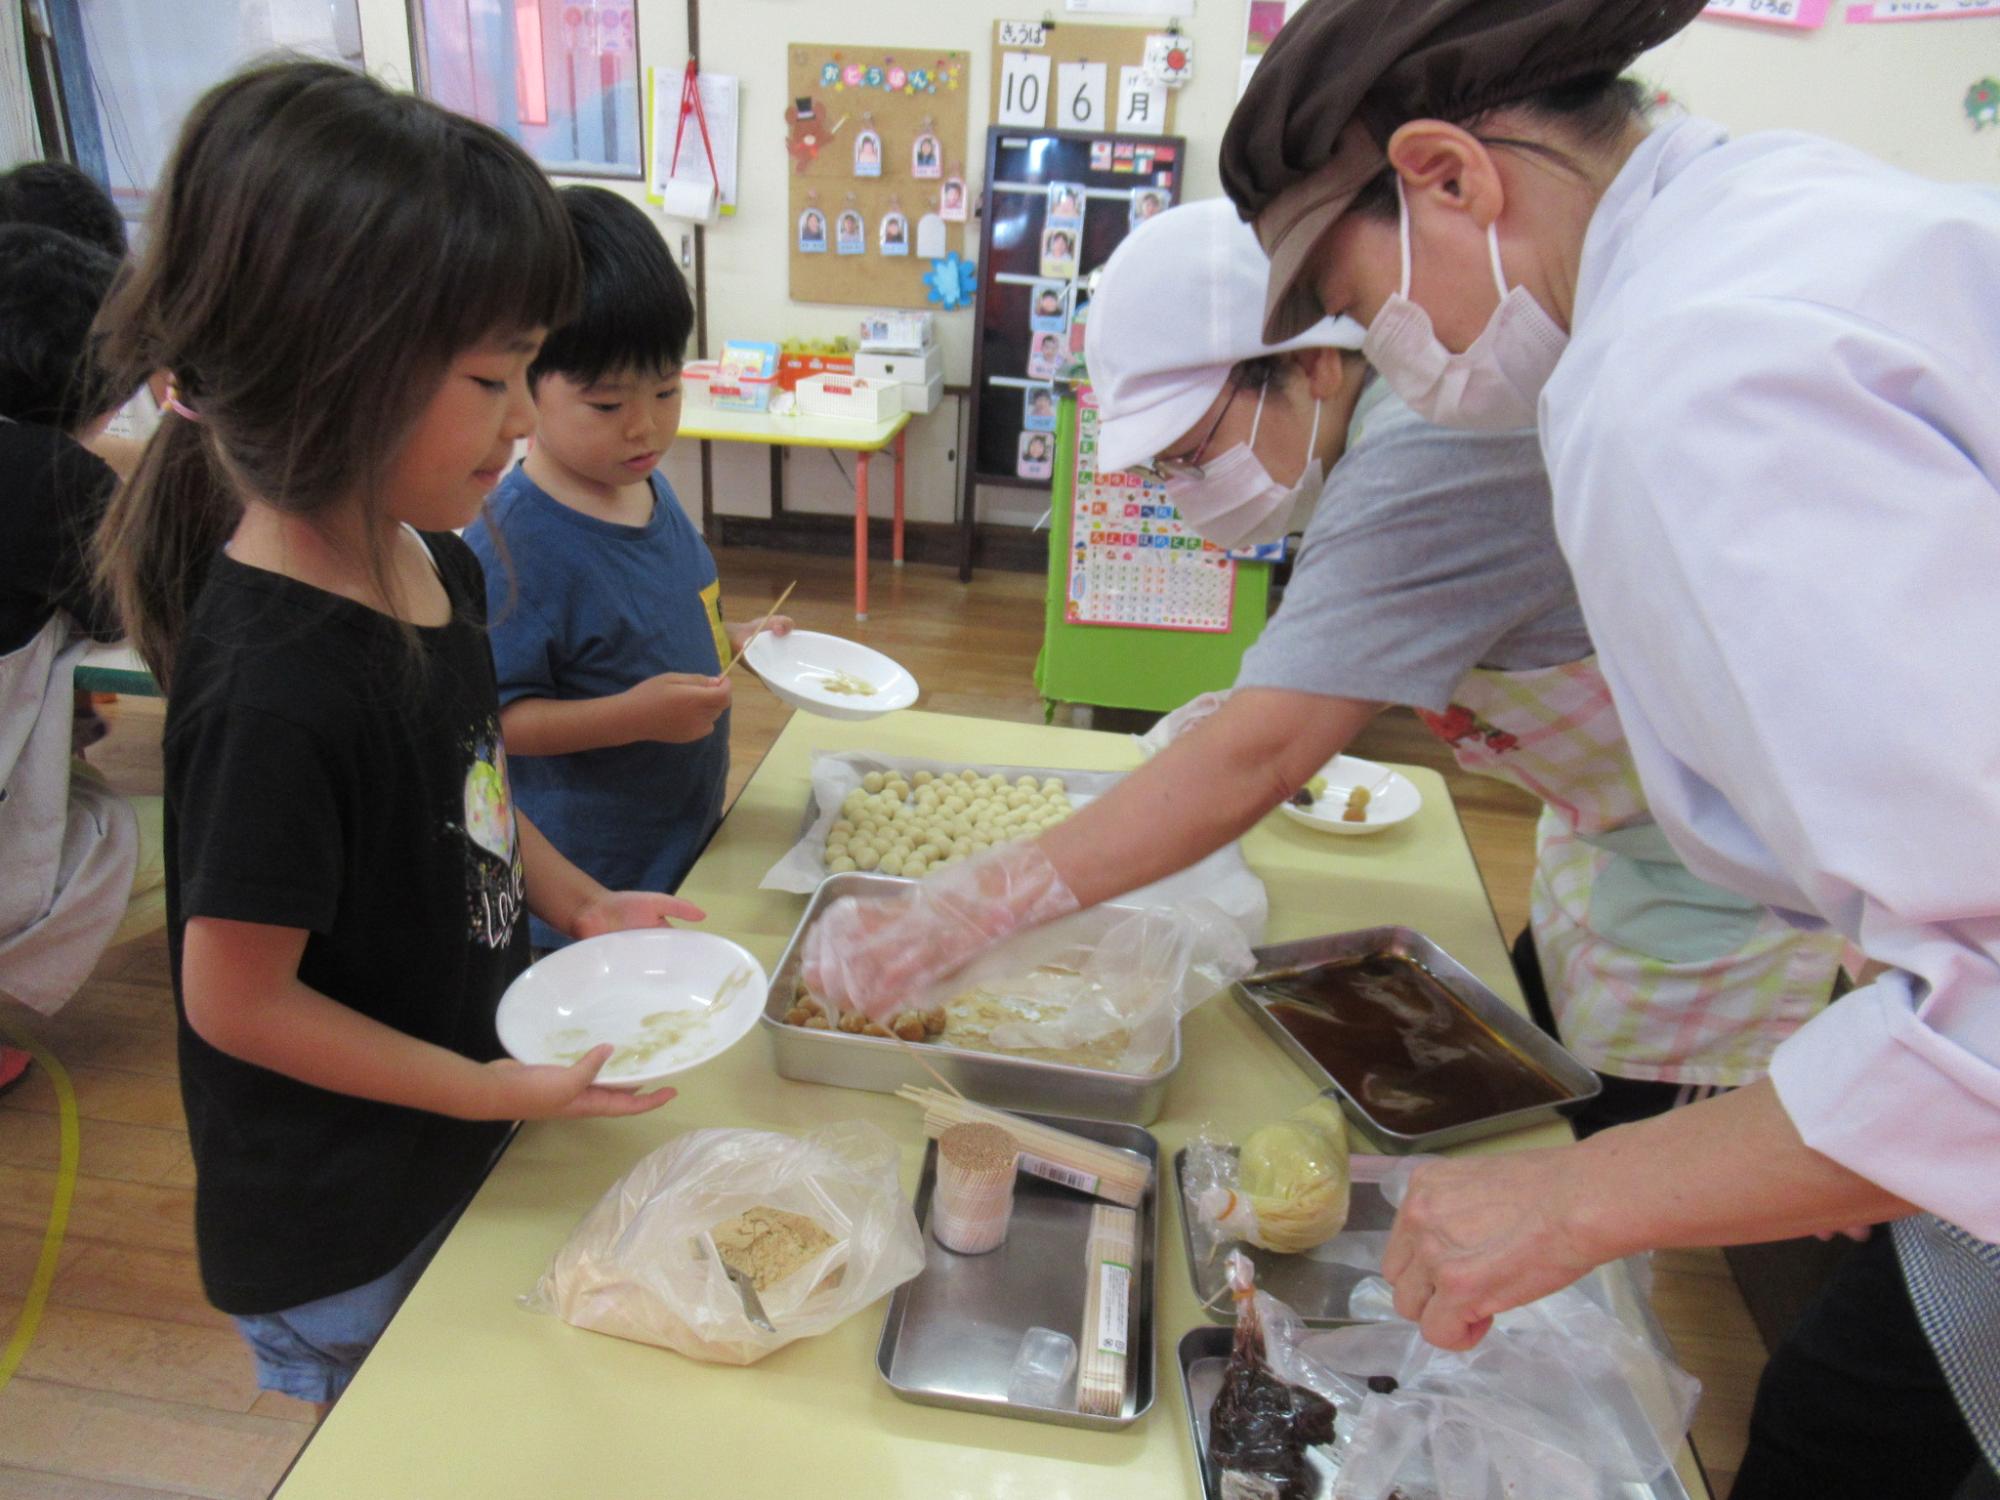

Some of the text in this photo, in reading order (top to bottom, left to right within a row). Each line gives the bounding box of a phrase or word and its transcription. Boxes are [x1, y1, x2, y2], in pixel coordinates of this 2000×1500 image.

[1006, 72, 1150, 122] 10 6 月
